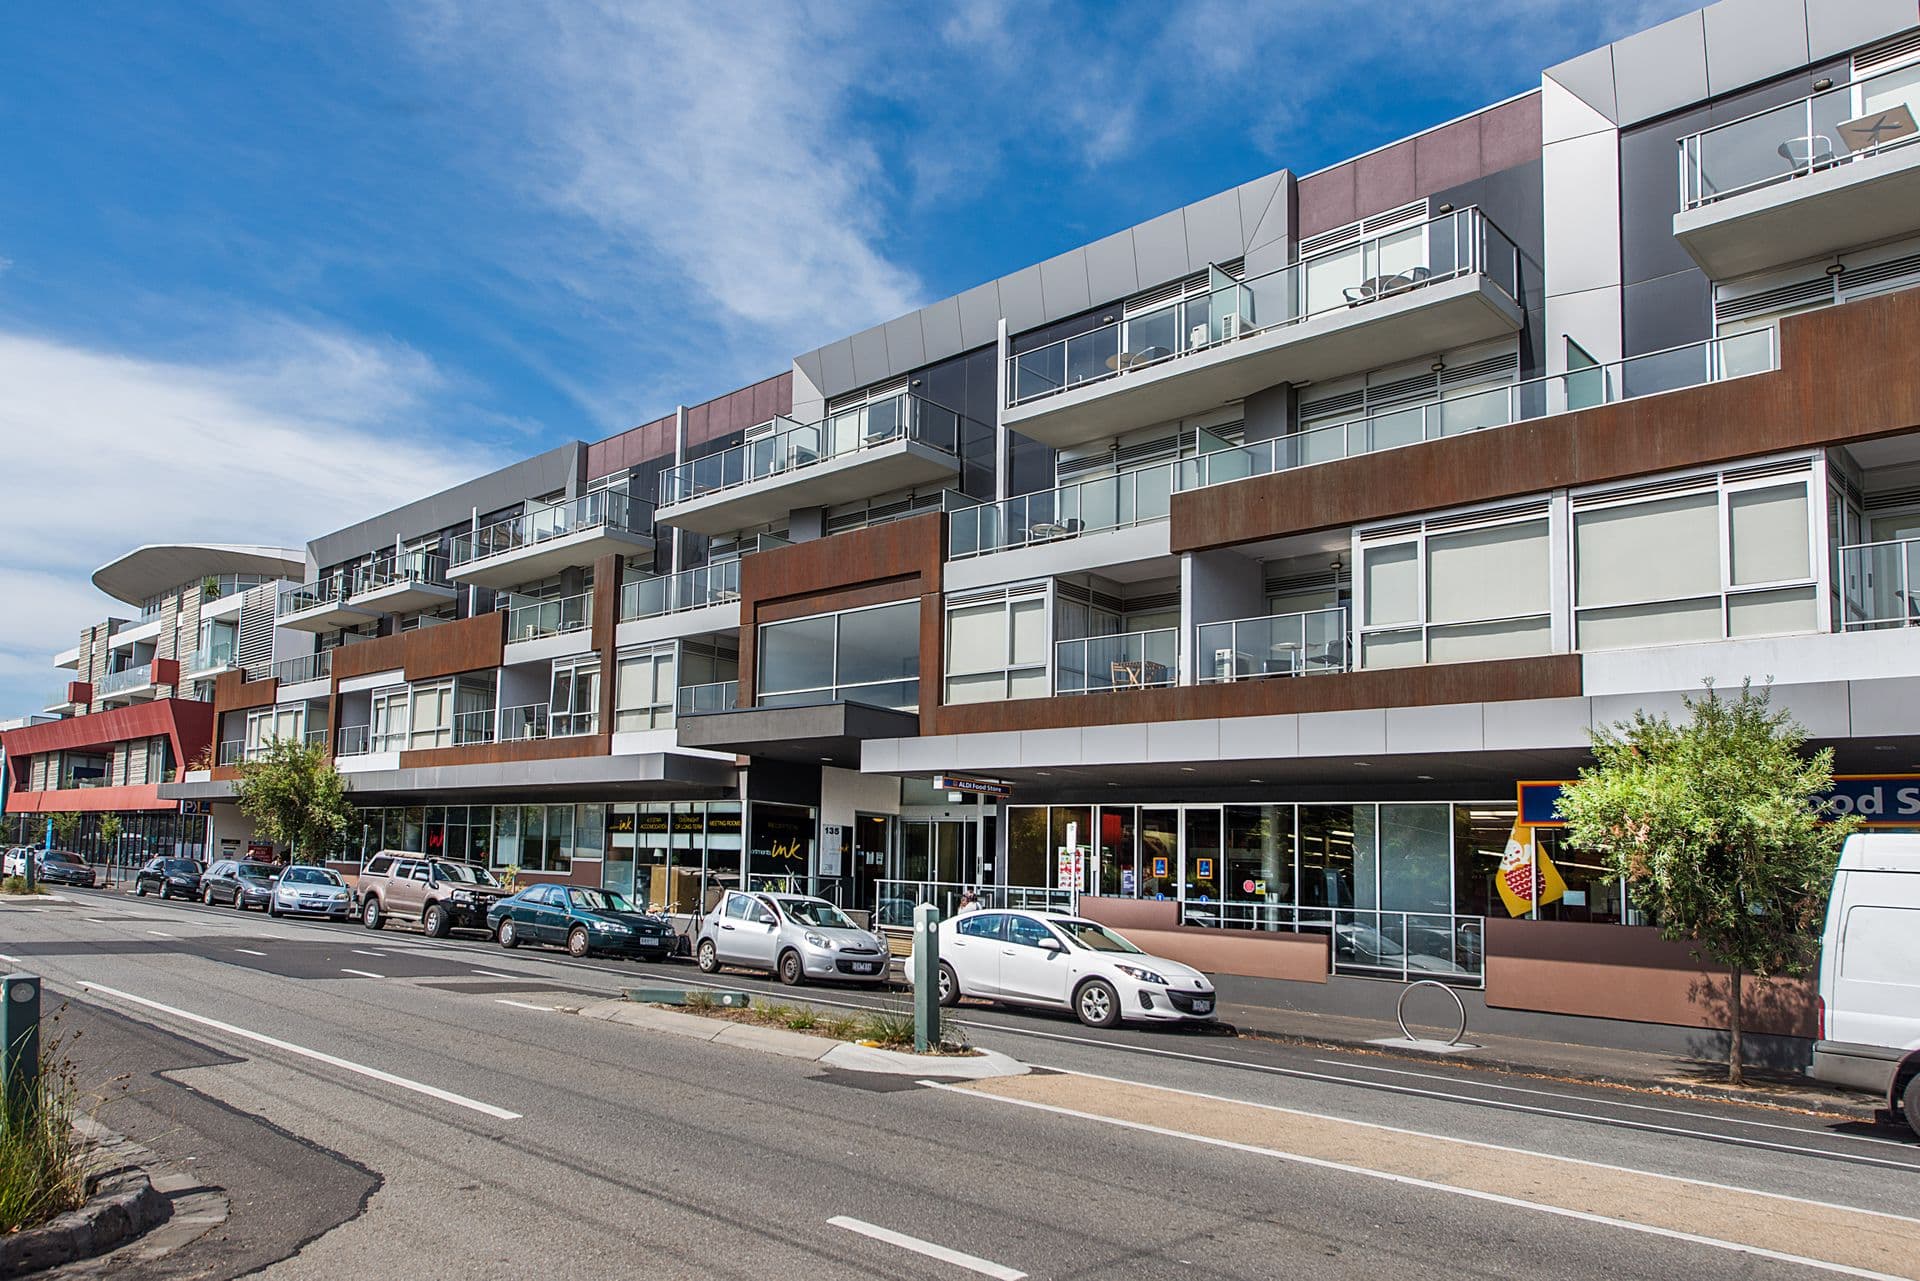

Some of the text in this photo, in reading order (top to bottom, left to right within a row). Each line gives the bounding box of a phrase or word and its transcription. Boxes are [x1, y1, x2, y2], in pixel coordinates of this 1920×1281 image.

[987, 784, 1002, 792] Store
[1805, 786, 1920, 815] ood S
[184, 801, 194, 813] P
[825, 827, 840, 835] 135
[772, 837, 803, 860] ink
